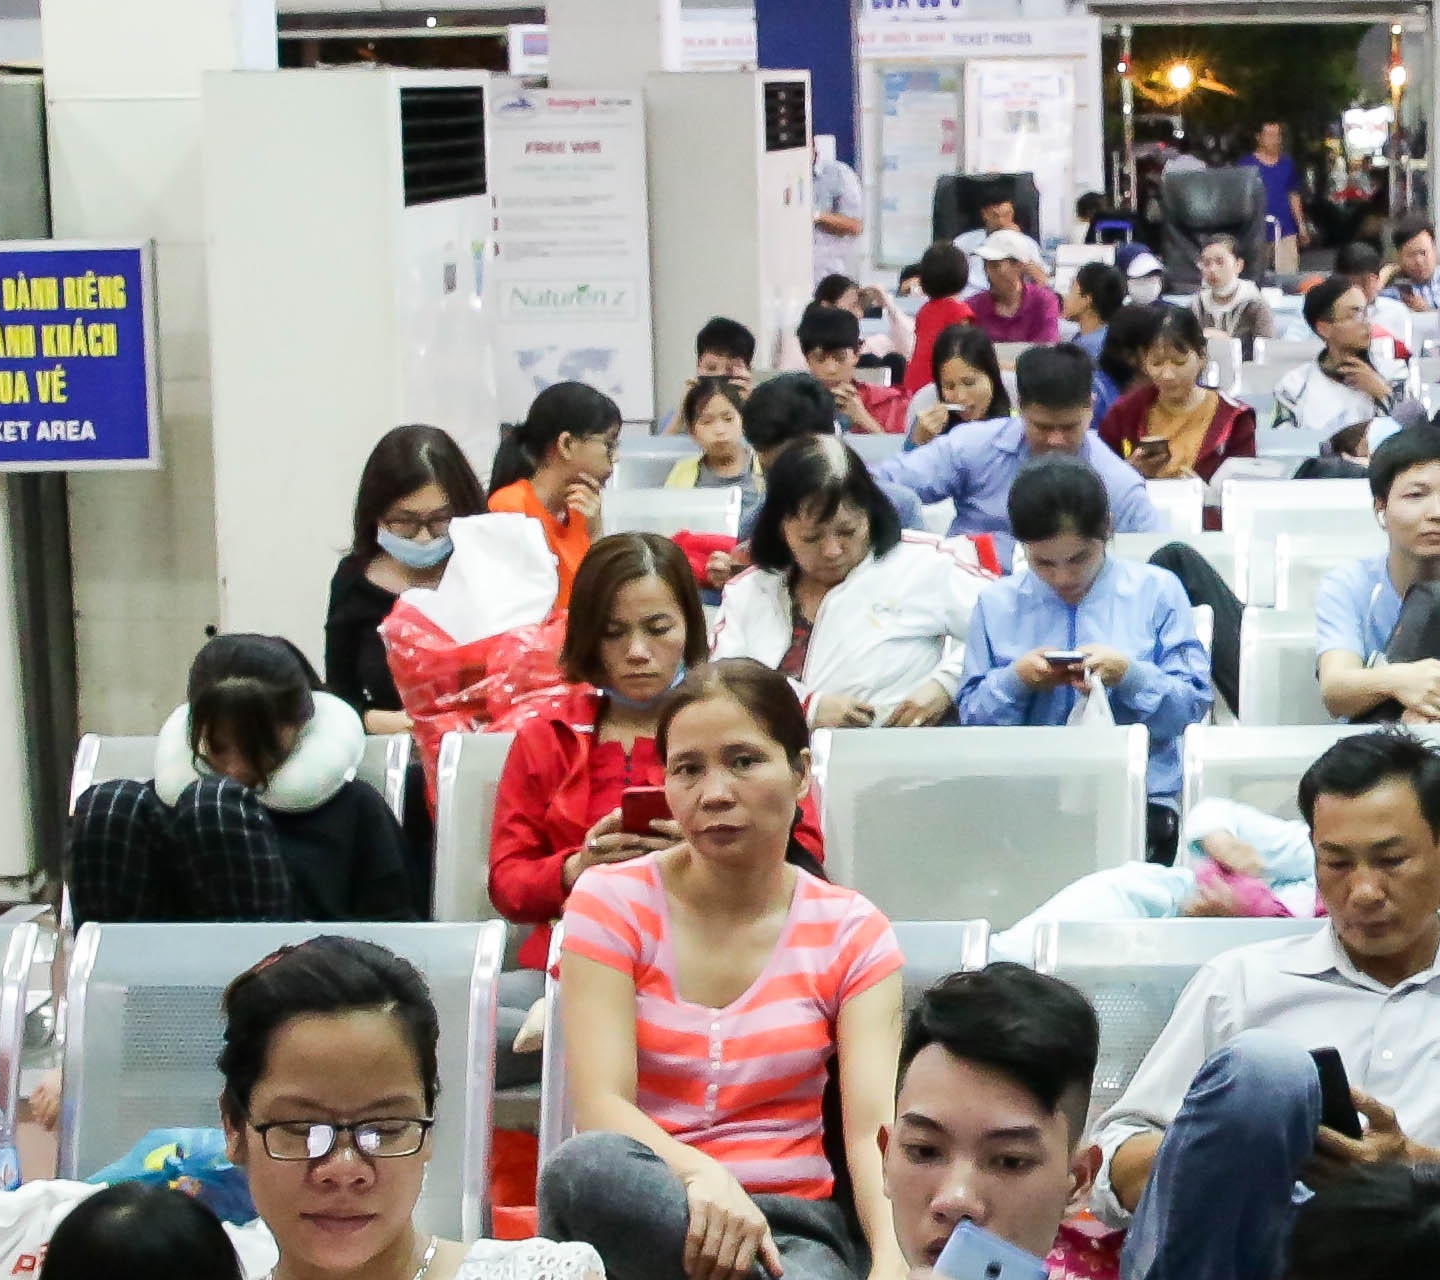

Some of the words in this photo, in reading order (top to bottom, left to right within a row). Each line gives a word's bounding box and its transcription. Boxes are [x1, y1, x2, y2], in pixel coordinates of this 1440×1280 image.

[2, 271, 59, 312] DÀNH
[63, 270, 127, 311] RIÊNG
[41, 317, 118, 358] KHÁCH
[35, 363, 68, 404] VÉ
[36, 420, 97, 441] AREA
